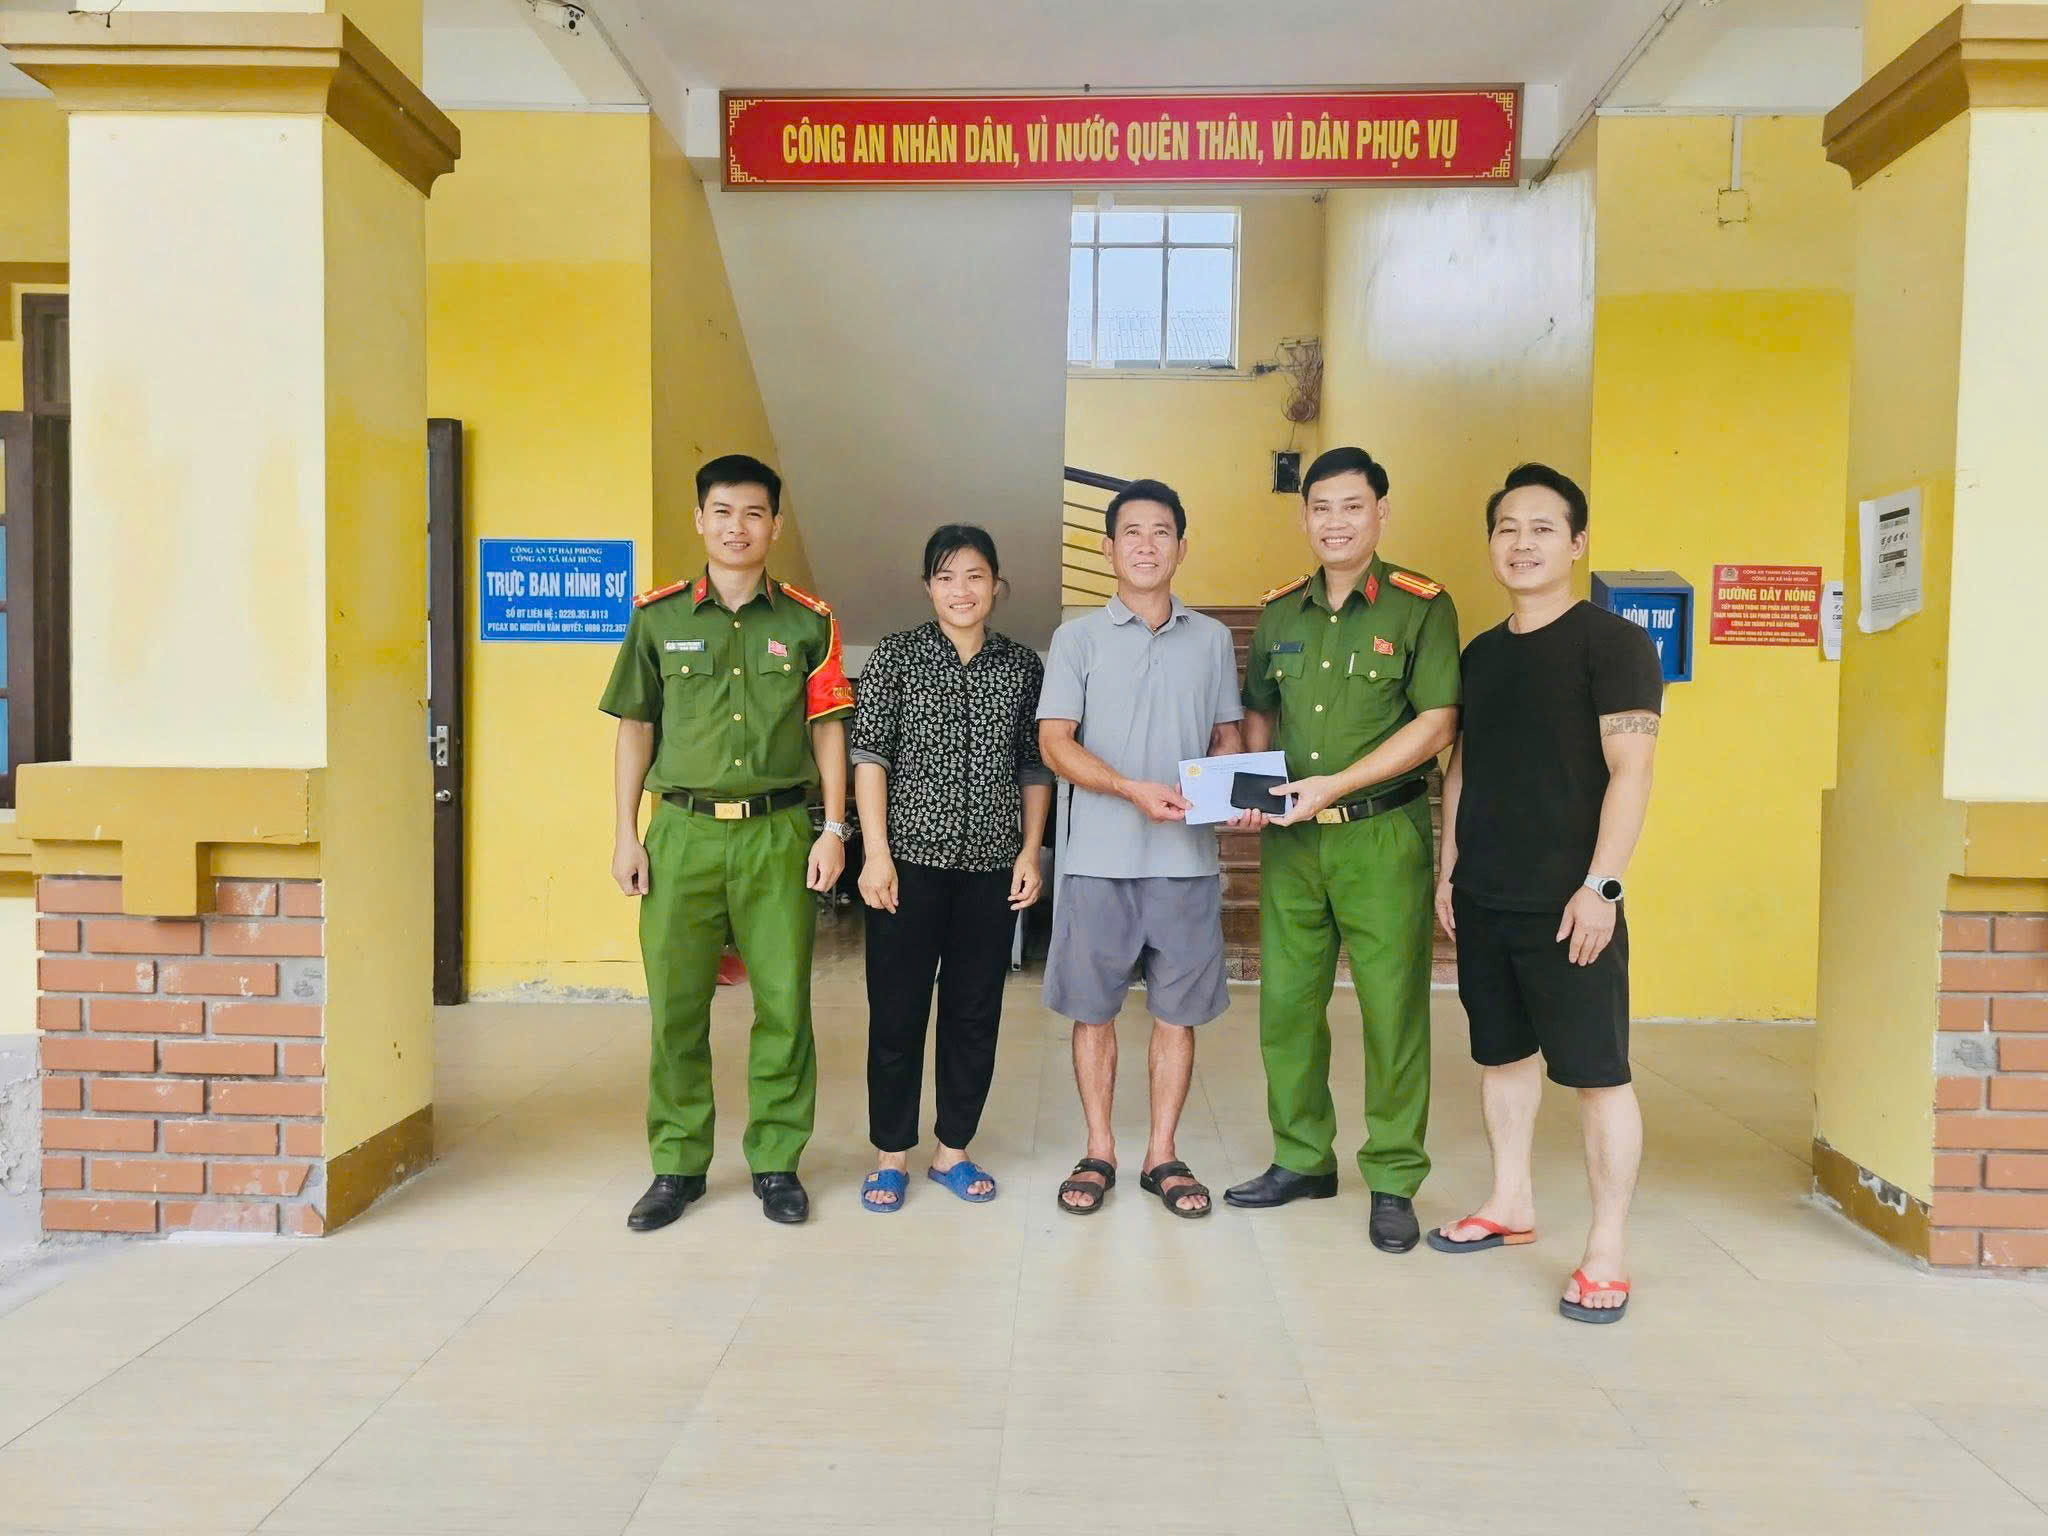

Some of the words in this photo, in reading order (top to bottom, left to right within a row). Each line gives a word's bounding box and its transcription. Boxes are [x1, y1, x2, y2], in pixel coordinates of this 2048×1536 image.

[783, 117, 845, 163] CÔNG
[854, 125, 885, 162] AN
[893, 116, 957, 162] NHÂN
[966, 116, 1019, 167] DÂN,
[1027, 115, 1048, 162] VÌ
[1056, 114, 1118, 161] NƯỚC
[1127, 114, 1188, 165] QUÊN
[1196, 113, 1263, 165] THÂN,
[1272, 112, 1293, 160] VÌ
[1301, 112, 1349, 159] DÂN
[1357, 120, 1419, 168] PHỤC
[1428, 120, 1457, 167] VỤ
[510, 545, 533, 554] CÔNG
[511, 554, 535, 563] CÔNG
[536, 555, 548, 563] AN
[486, 569, 525, 602] TRỰC
[529, 572, 561, 597] BAN
[564, 567, 601, 598] HÌNH
[604, 570, 628, 603] SỰ
[1718, 586, 1757, 601] ĐƯỜNG
[1759, 586, 1782, 601] DÂY
[1784, 587, 1816, 602] NÓNG
[1651, 607, 1676, 629] THƯ
